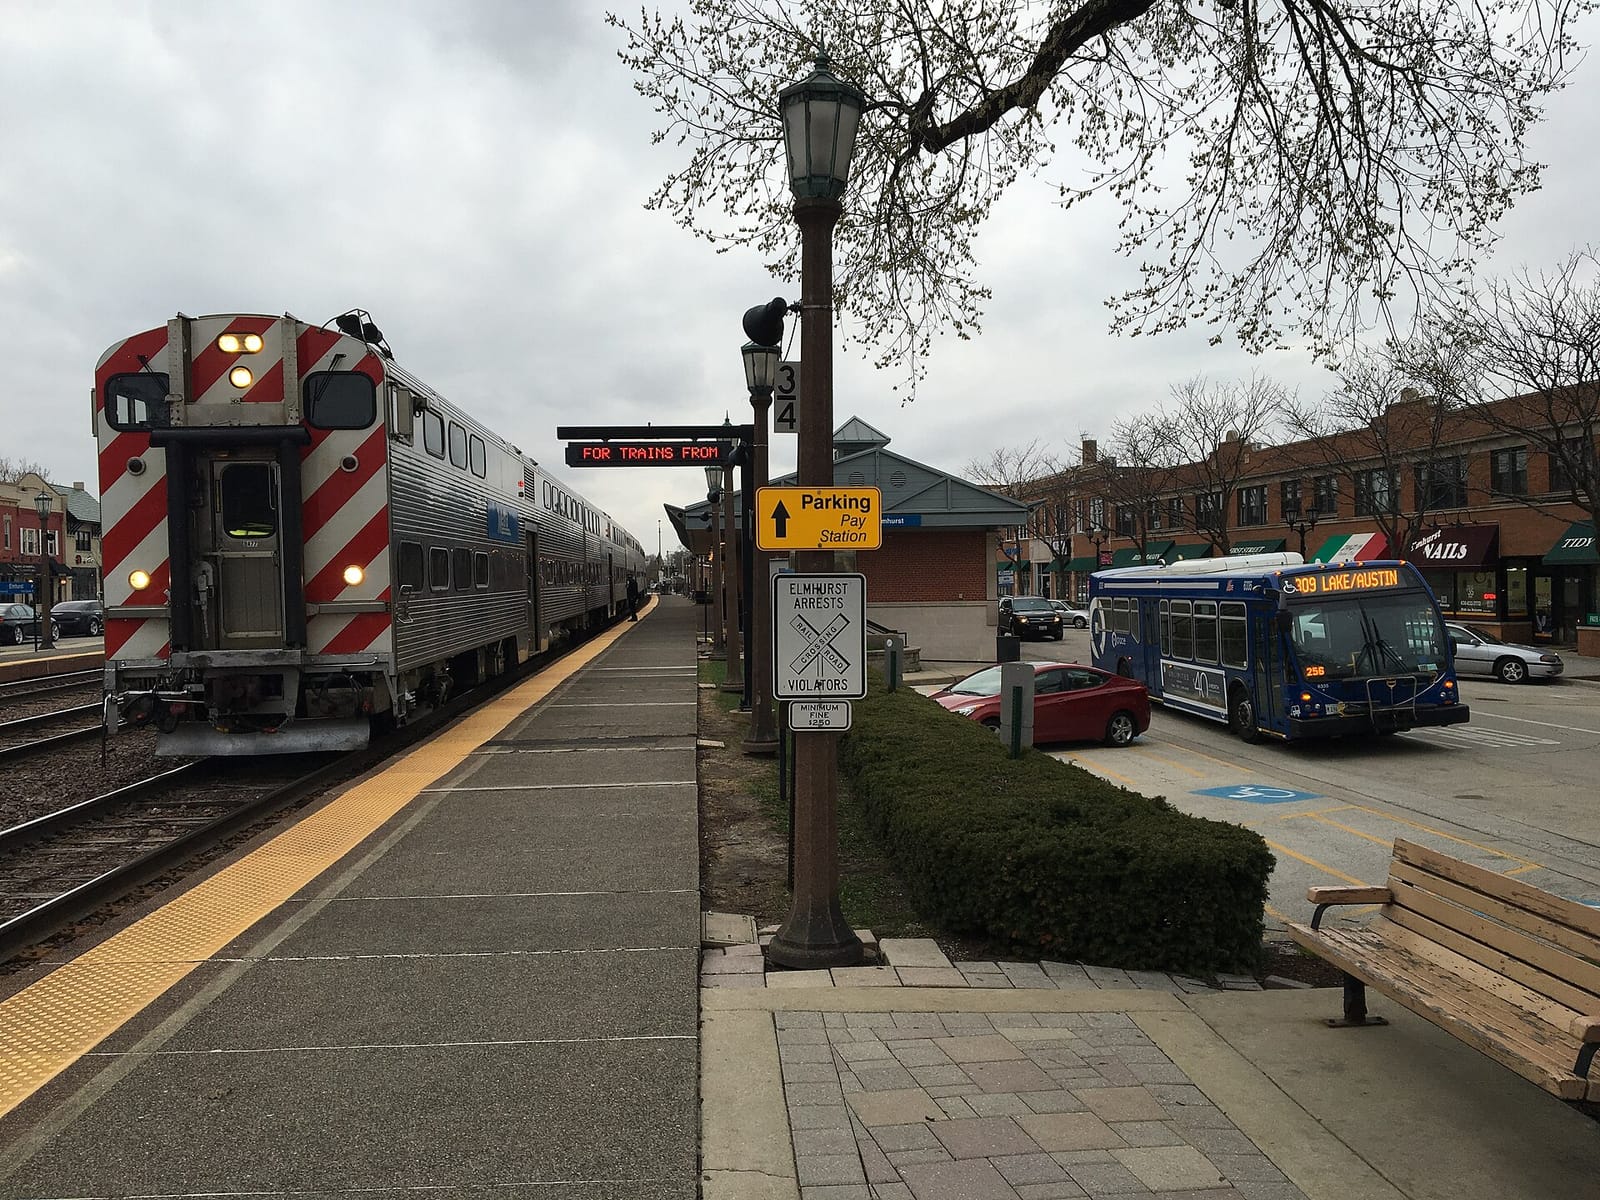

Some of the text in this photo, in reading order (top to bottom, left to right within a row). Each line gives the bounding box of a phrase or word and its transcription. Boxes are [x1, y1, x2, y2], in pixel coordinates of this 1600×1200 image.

[777, 365, 796, 395] 3
[776, 402, 797, 430] 4
[583, 446, 719, 460] FOR TRAINS FROM
[801, 494, 871, 513] Parking
[840, 514, 867, 528] Pay
[881, 517, 905, 525] mhurst
[819, 530, 867, 543] Station
[1561, 537, 1595, 549] TIDY
[1423, 542, 1468, 560] NAILS
[1295, 569, 1399, 594] 309 LAKE/AUSTIN
[789, 582, 849, 596] ELMHURST
[793, 597, 844, 609] ARRESTS
[796, 622, 812, 640] RAIL
[800, 626, 837, 664] CROSSING
[823, 649, 844, 669] ROAD
[788, 679, 848, 692] VIOLATORS
[800, 704, 839, 712] MINIMUM
[808, 719, 831, 727] $250
